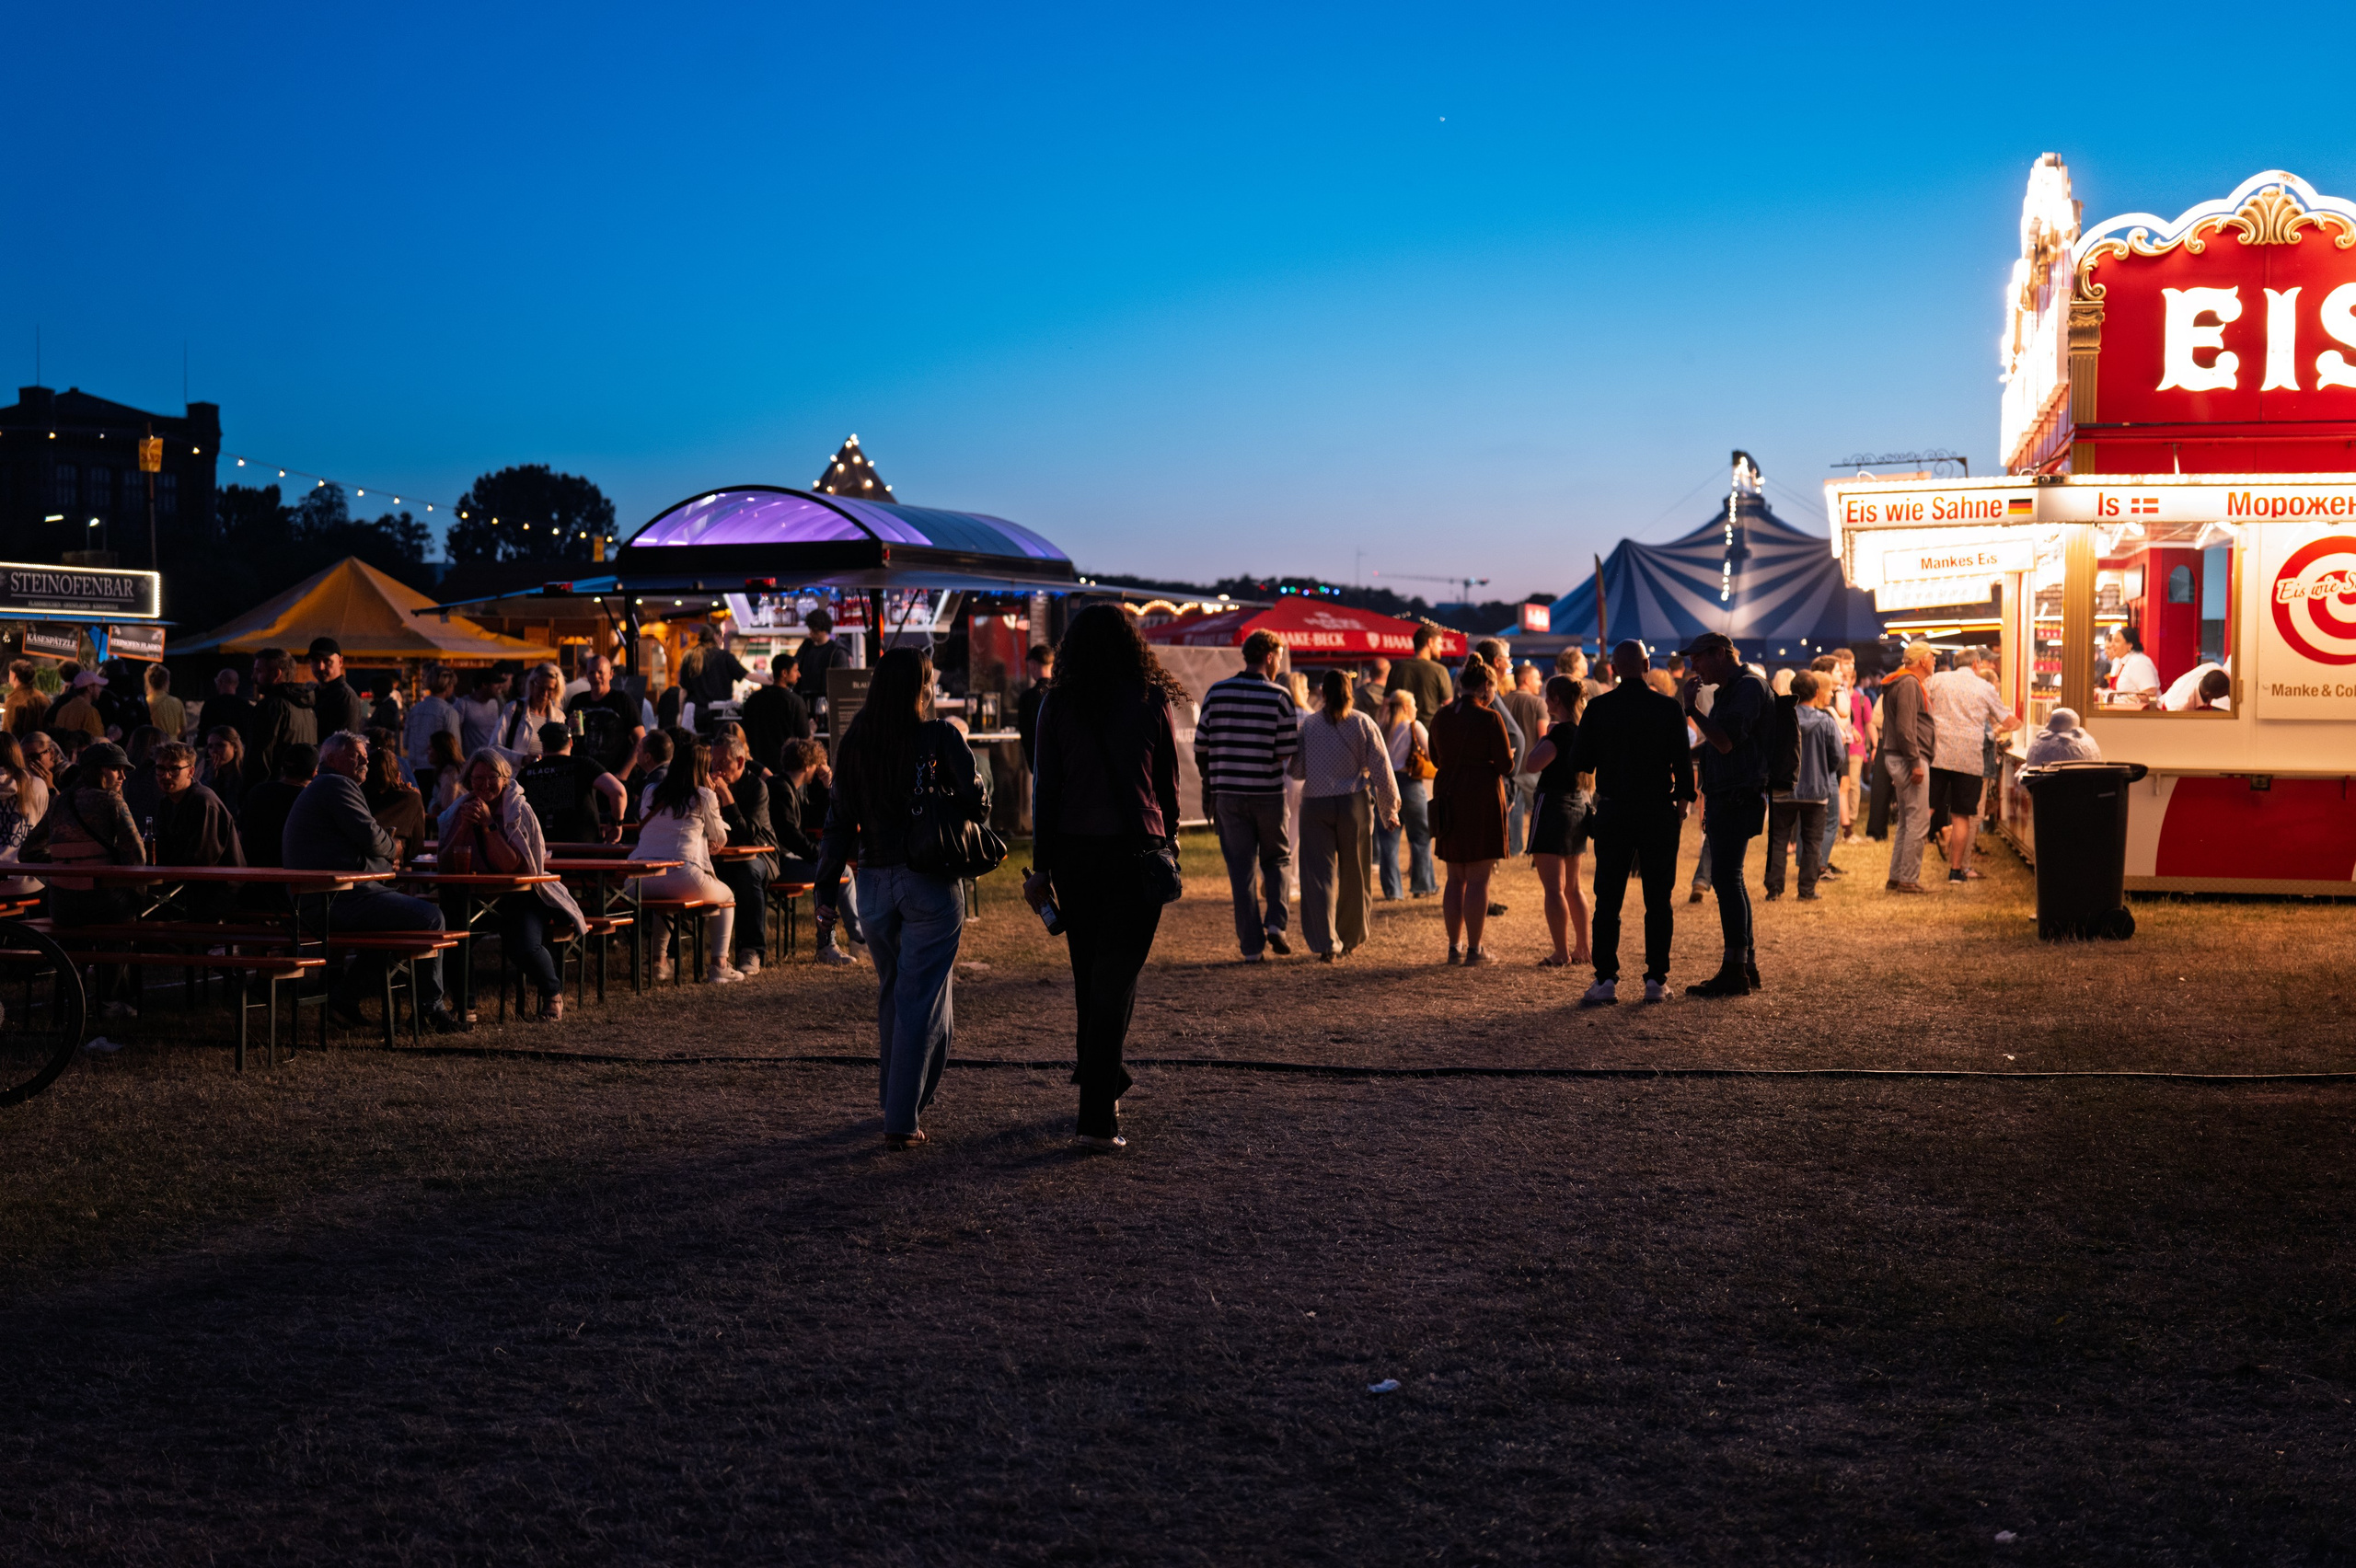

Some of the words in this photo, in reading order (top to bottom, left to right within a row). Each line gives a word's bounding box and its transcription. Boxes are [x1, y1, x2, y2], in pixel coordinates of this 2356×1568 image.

[1846, 500, 1877, 524] Eis
[1885, 498, 1923, 522] wie
[1932, 495, 2003, 521] Sahne
[2097, 492, 2120, 516] Is
[1920, 555, 1974, 571] Mankes
[10, 571, 134, 597] STEINOFENBAR
[2279, 581, 2305, 600] Eis
[2311, 578, 2339, 596] wie
[1274, 630, 1345, 647] AAKE-BECK
[2271, 683, 2319, 698] Manke
[2321, 683, 2332, 698] &
